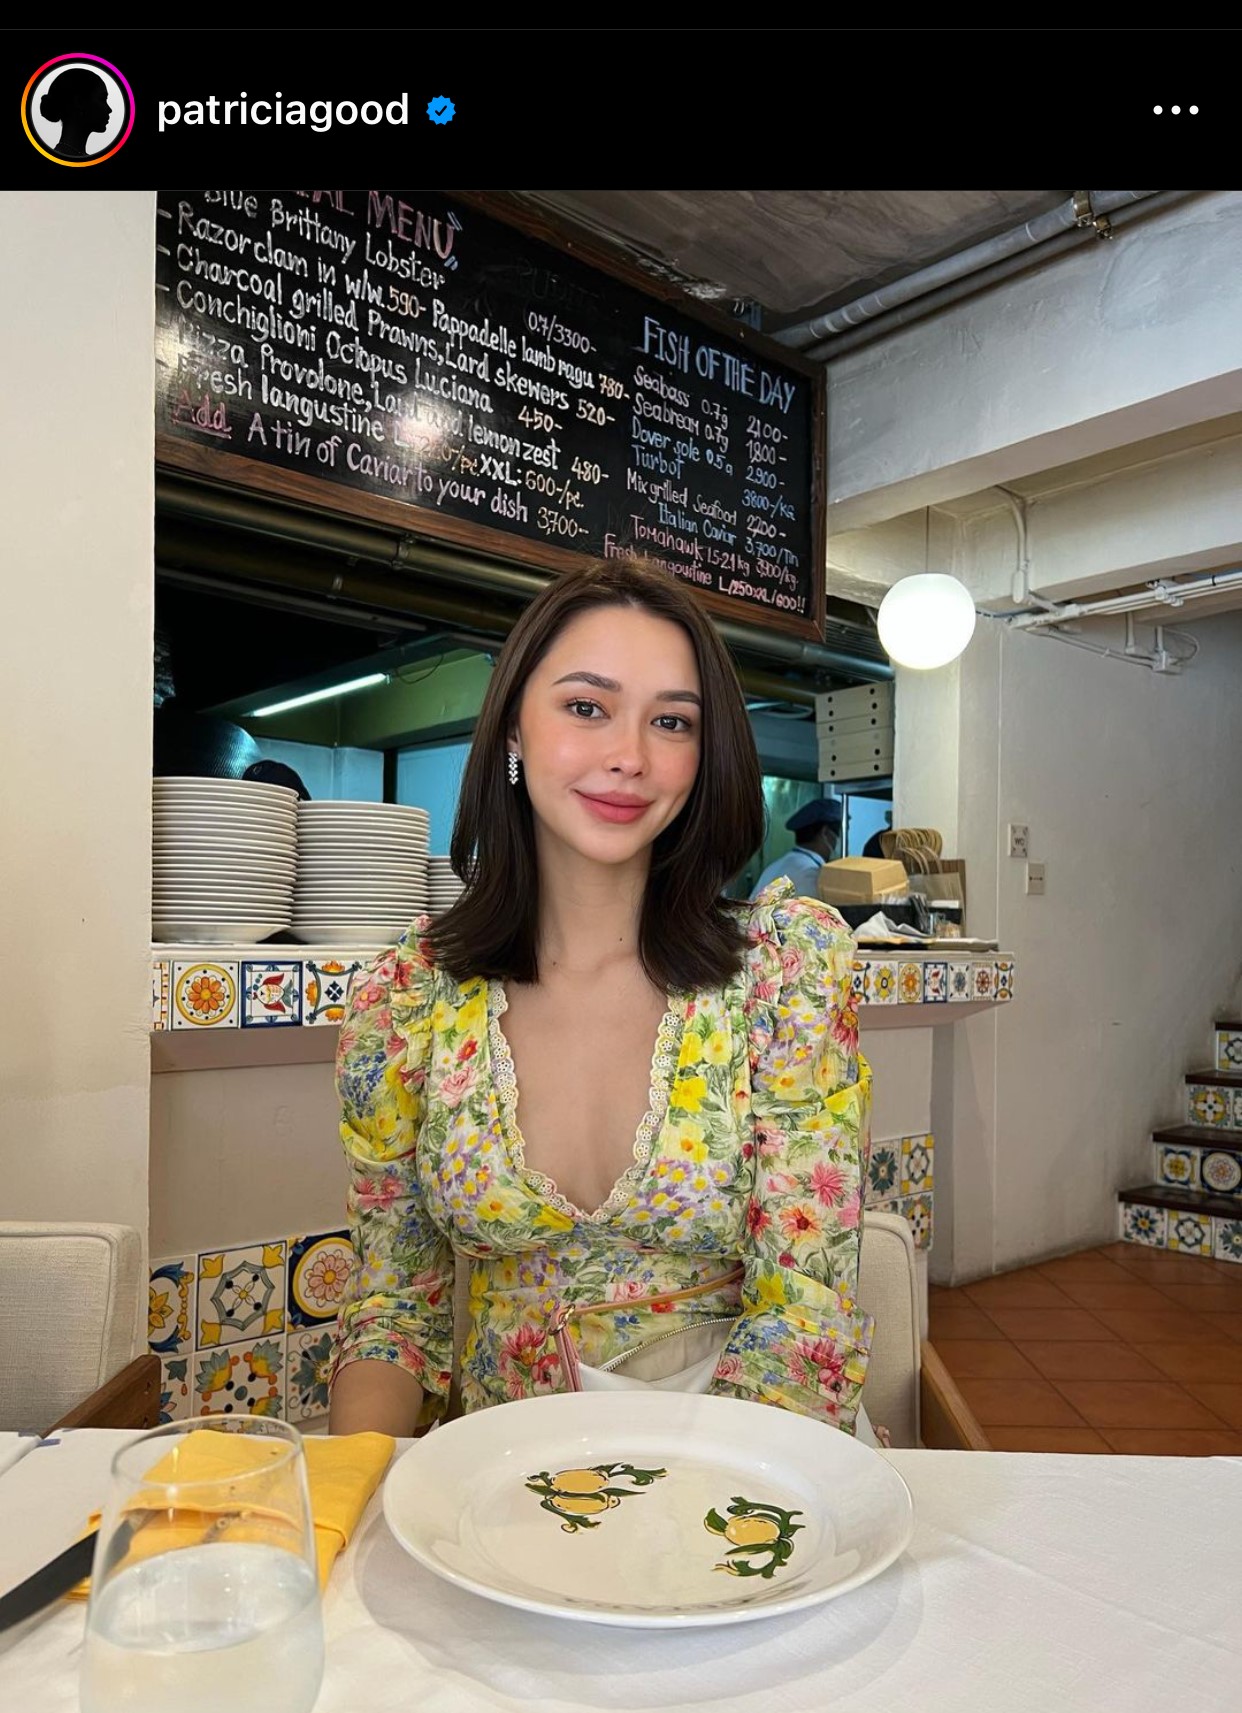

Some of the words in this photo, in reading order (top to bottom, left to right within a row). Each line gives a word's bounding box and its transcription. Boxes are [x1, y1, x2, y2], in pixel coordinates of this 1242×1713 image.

[270, 198, 356, 264] Brittany
[366, 231, 445, 290] Lobster
[367, 190, 455, 259] MENU
[177, 243, 282, 305] Charcoal
[289, 287, 359, 331] grilled
[494, 360, 569, 410] skewers
[178, 200, 251, 254] Razor
[254, 230, 308, 277] clam
[318, 256, 336, 286] in
[432, 298, 517, 358] Pappadelle
[521, 335, 555, 372] lamb
[558, 359, 595, 389] ragu
[177, 280, 316, 351] Conchiglioni
[326, 330, 407, 388] Octopus
[642, 316, 690, 373] FISH
[695, 346, 720, 380] OF
[721, 352, 754, 397] THE
[759, 370, 796, 414] DAY
[262, 374, 385, 442] langustine
[633, 365, 690, 408] Seabass
[172, 389, 232, 433] Add
[247, 412, 267, 446] A
[270, 419, 311, 458] tin
[316, 435, 342, 467] of
[347, 442, 413, 486] Caviar
[414, 461, 433, 492] to
[437, 478, 486, 506] your
[490, 487, 528, 523] dish
[468, 414, 520, 458] lemon
[522, 438, 561, 470] zest
[631, 444, 685, 480] Turbot
[632, 415, 671, 449] Dover
[673, 437, 701, 463] sole
[626, 467, 646, 494] Mix
[647, 478, 688, 508] grilled
[692, 494, 737, 526] Seafood
[657, 501, 698, 533] Italian
[703, 518, 737, 546] Caviar
[1014, 837, 1025, 846] WC
